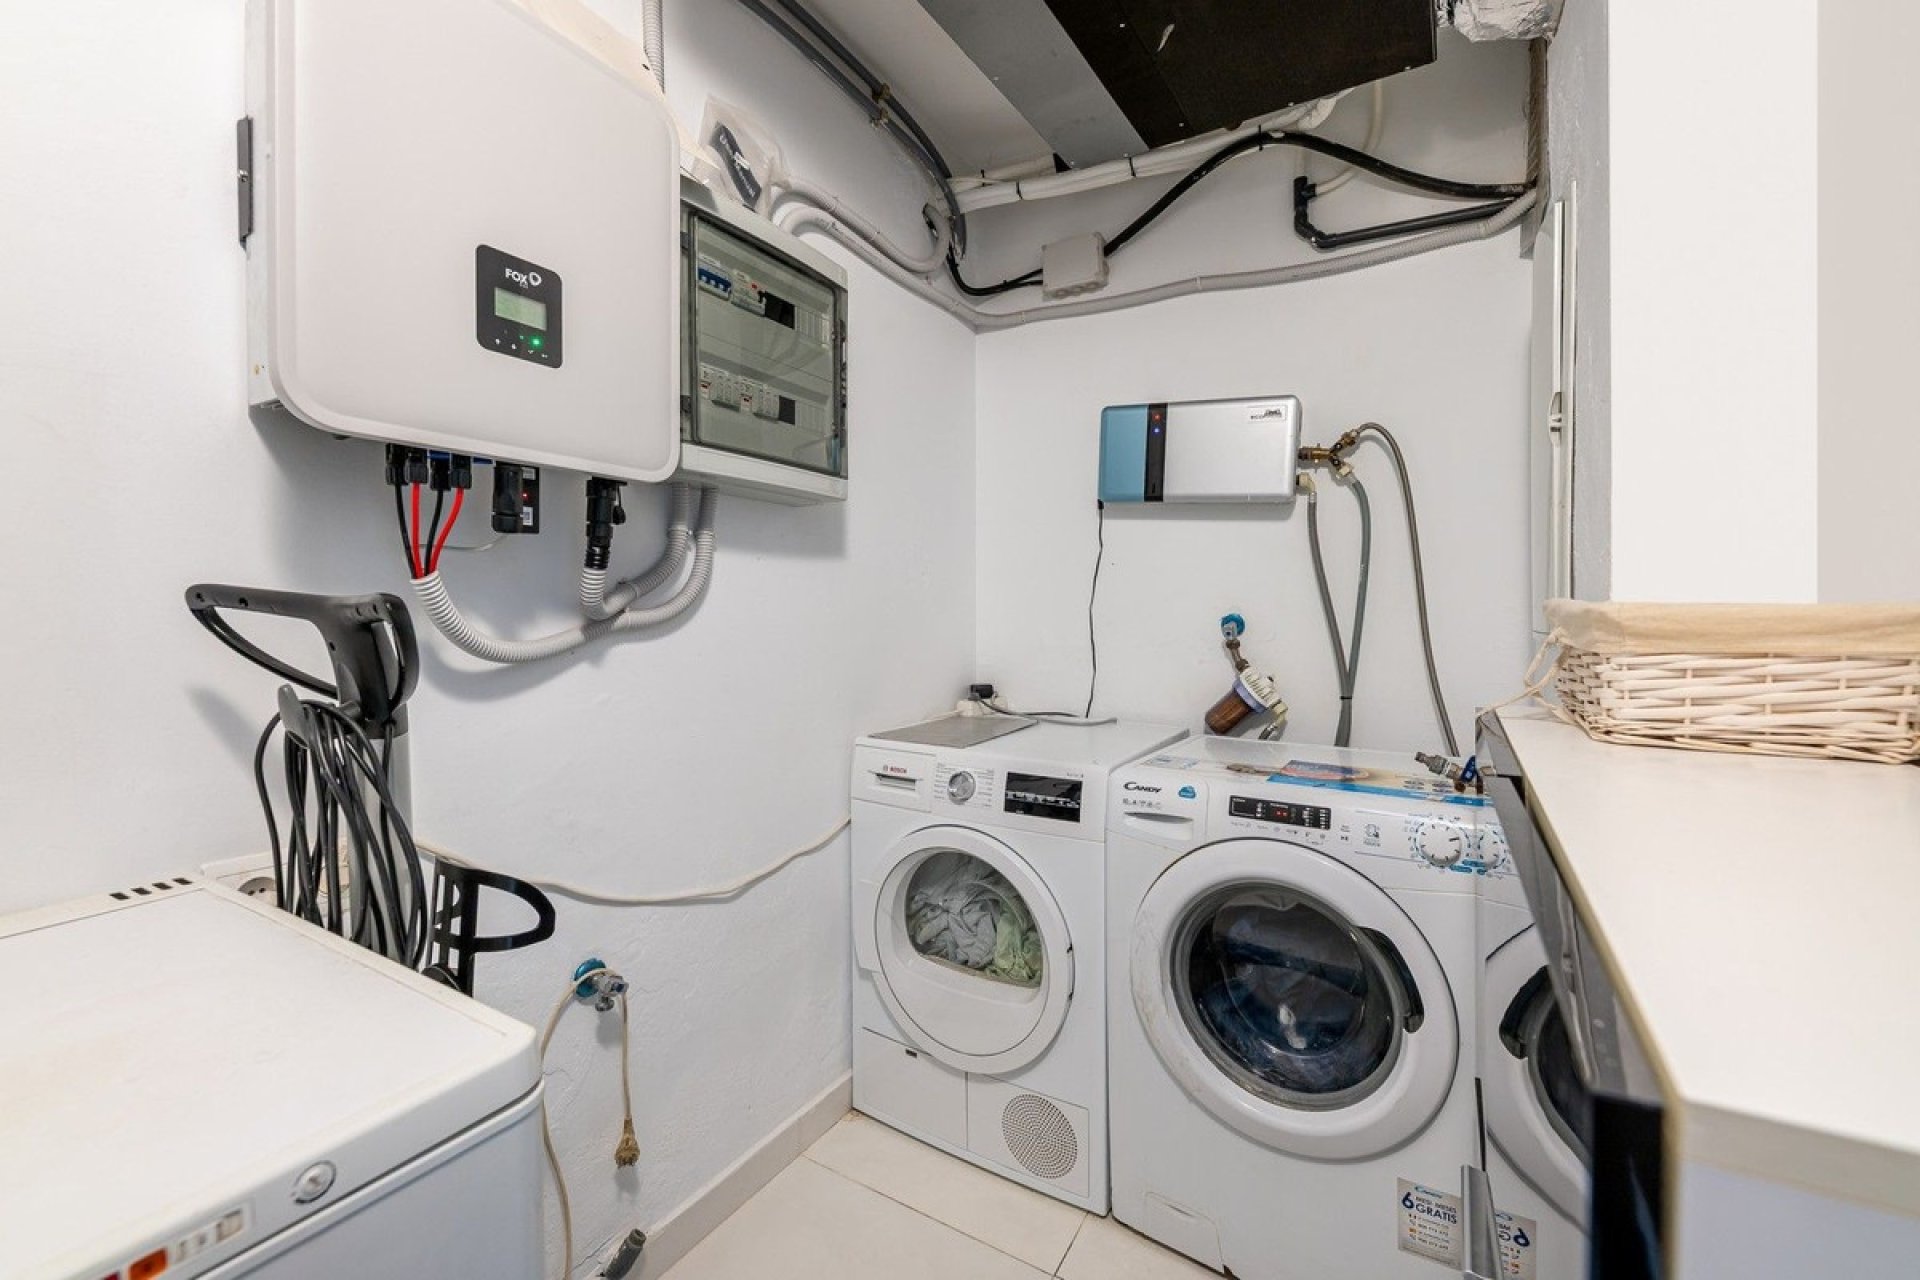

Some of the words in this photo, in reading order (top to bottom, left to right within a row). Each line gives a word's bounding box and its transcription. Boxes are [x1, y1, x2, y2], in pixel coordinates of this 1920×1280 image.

[889, 766, 908, 775] BOSCH
[1401, 1191, 1414, 1209] 6
[1415, 1203, 1457, 1224] GRATIS
